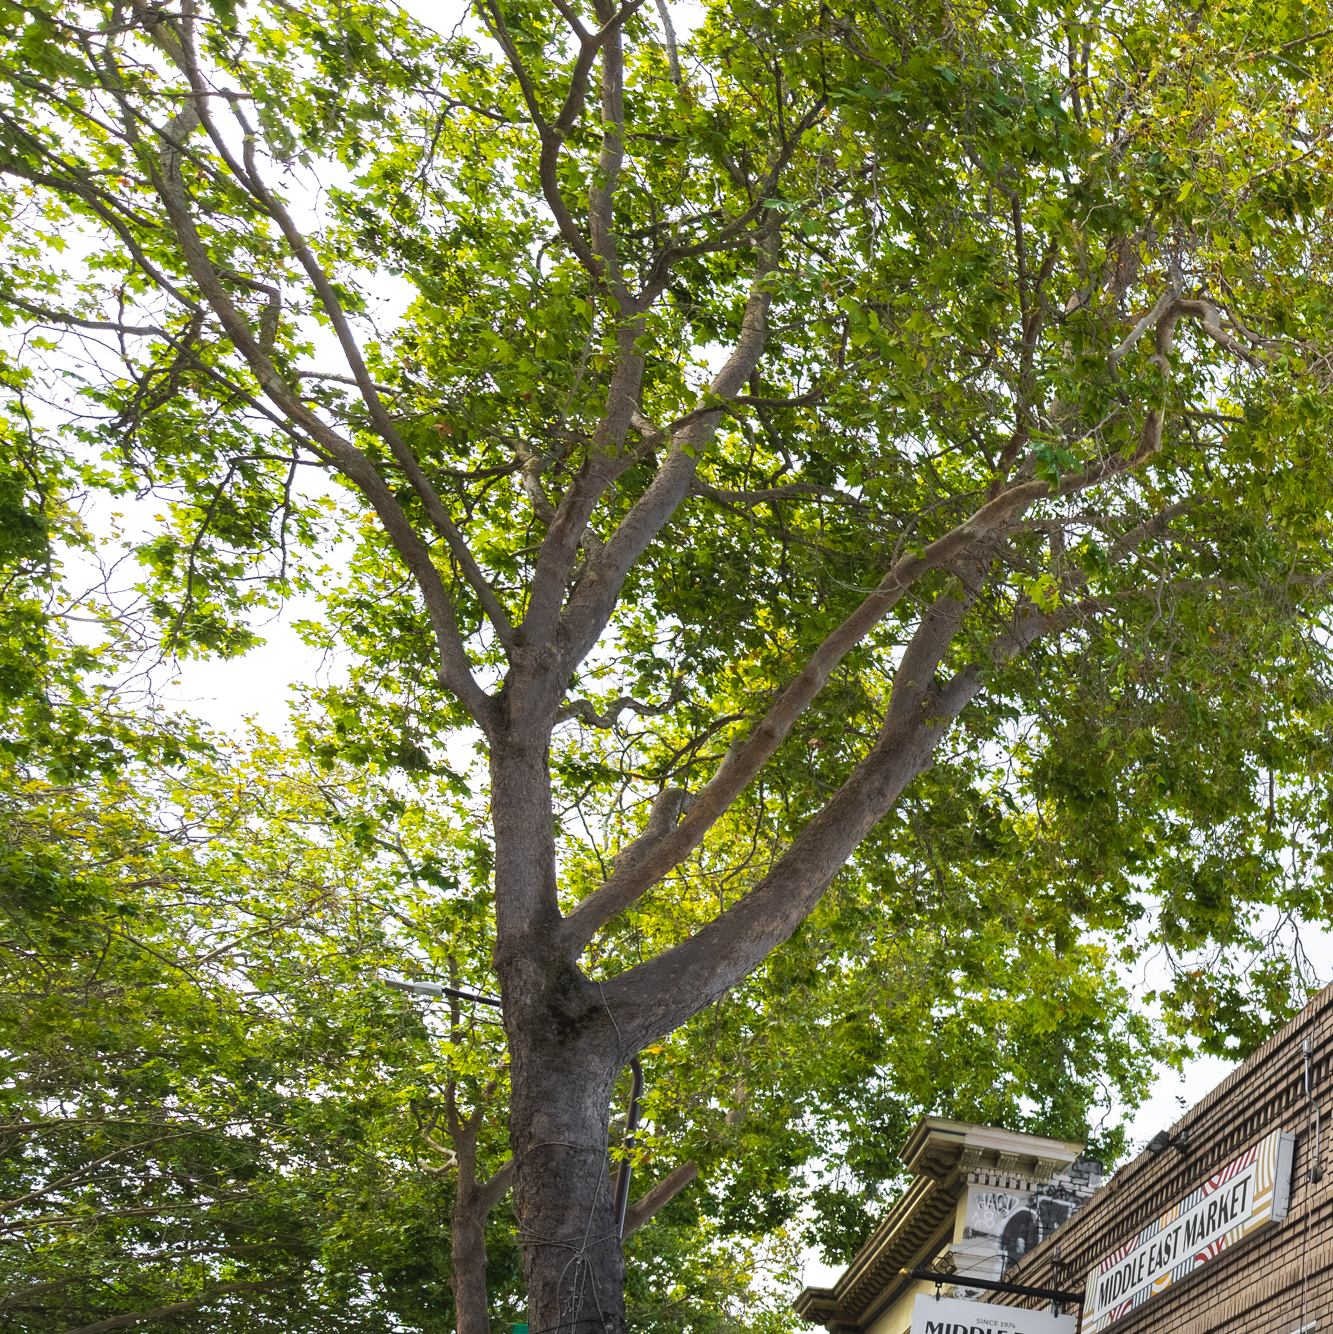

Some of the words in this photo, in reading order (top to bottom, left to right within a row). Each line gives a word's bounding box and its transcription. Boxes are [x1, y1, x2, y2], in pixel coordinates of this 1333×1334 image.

[1097, 1250, 1145, 1312] MIDDLE
[1147, 1225, 1182, 1277] EAST
[1182, 1174, 1252, 1254] MARKET
[975, 1318, 999, 1327] SINCE
[1000, 1321, 1016, 1329] 1974
